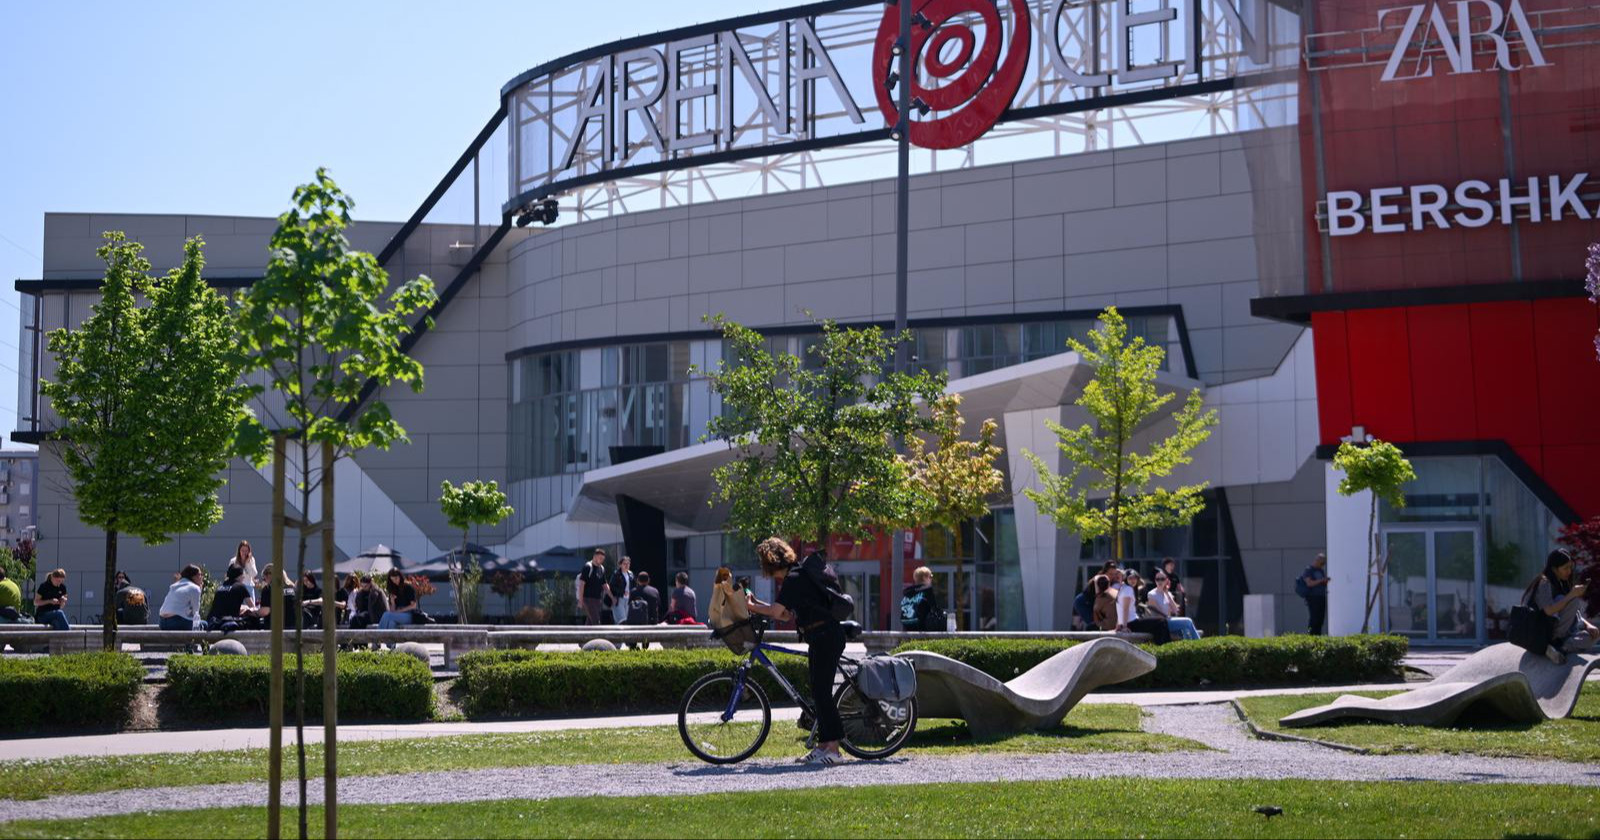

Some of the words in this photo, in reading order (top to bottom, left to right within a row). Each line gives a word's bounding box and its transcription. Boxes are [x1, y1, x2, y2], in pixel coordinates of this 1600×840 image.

[1377, 0, 1555, 82] ZARA
[559, 16, 865, 171] ARENA
[1327, 172, 1600, 236] BERSHK
